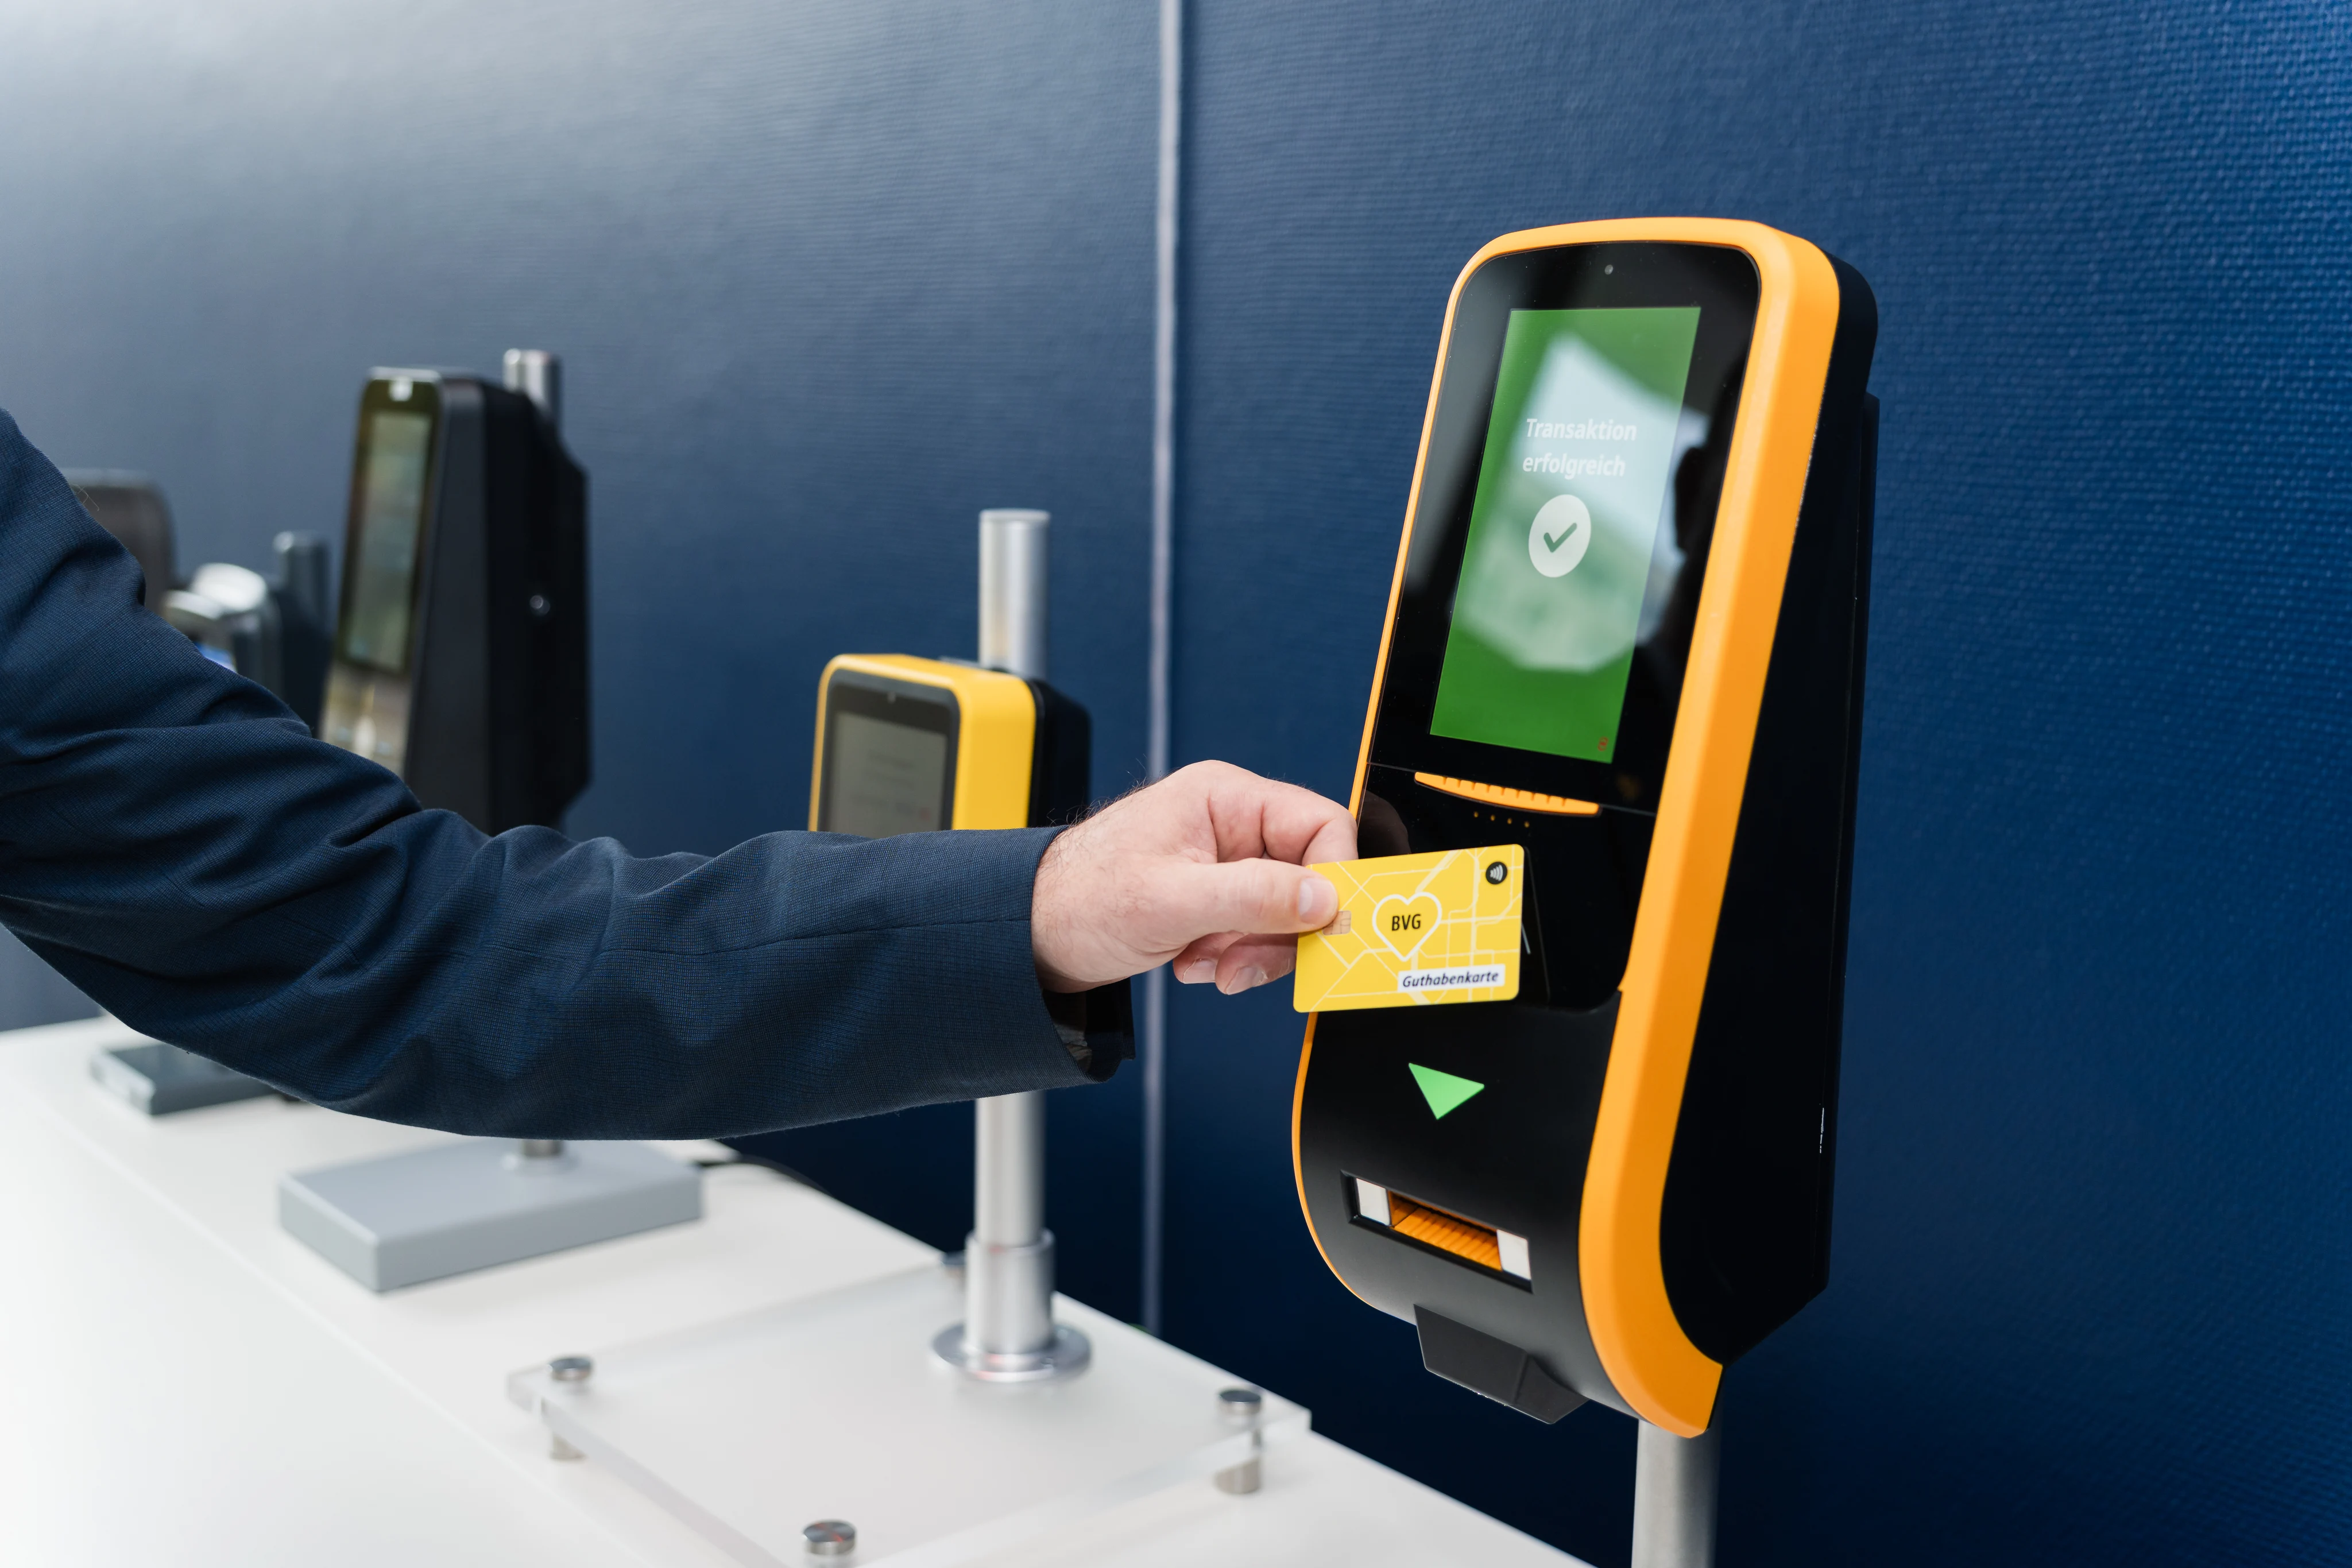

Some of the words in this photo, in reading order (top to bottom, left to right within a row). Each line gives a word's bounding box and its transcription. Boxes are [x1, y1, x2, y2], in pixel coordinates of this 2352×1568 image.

[1526, 418, 1637, 440] Transaktion
[1522, 452, 1624, 479] erfolgreich
[1391, 913, 1421, 931] BVG
[1402, 971, 1499, 988] Guthabenkarte
